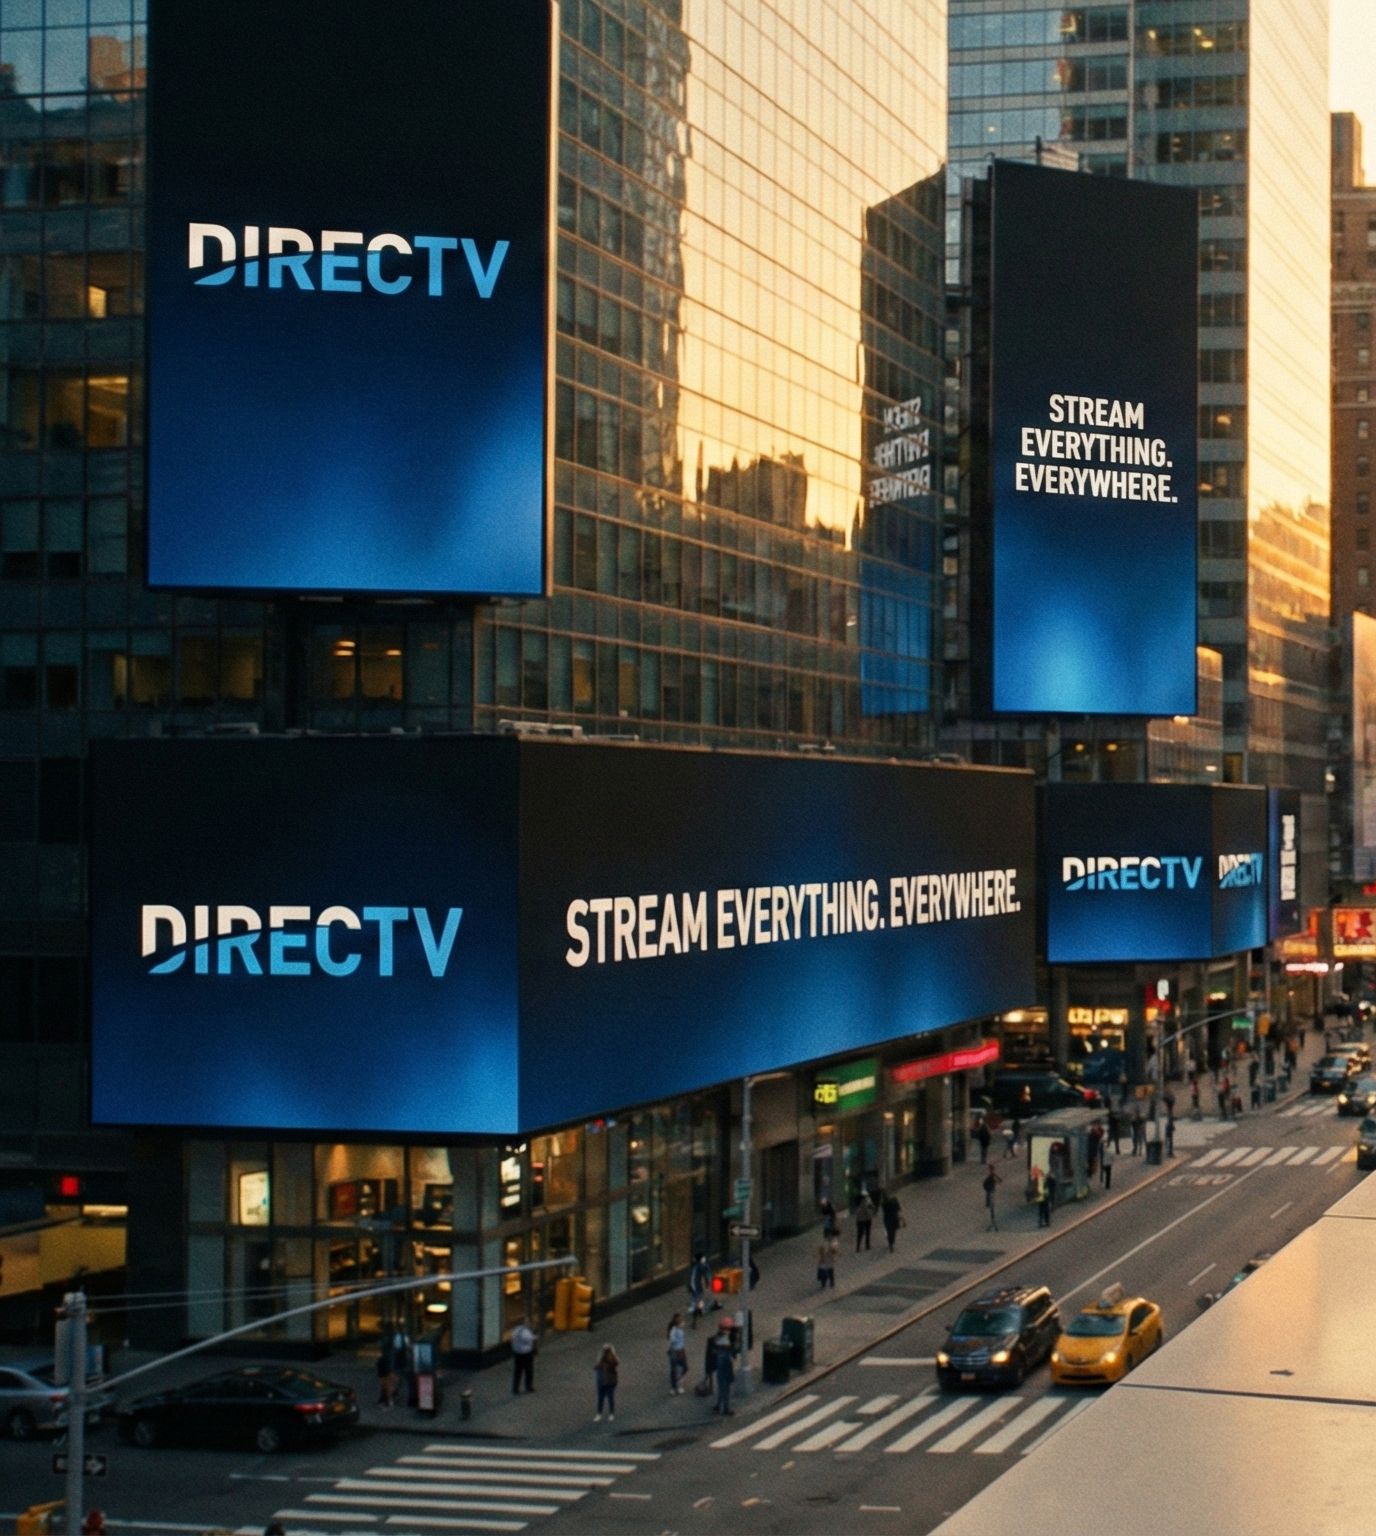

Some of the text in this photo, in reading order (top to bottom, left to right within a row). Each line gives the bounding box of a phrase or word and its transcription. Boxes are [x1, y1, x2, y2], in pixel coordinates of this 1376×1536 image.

[188, 222, 510, 299] DIRECTV
[1048, 393, 1145, 430] STREAM
[1020, 427, 1173, 468] EVERYTHING.
[1014, 462, 1179, 504] EVERYWHERE.
[1062, 856, 1203, 891] DIRECTV
[565, 868, 1021, 968] STREAM EVERYTHING. EVERYWHERE.
[142, 904, 463, 977] DIRECTV
